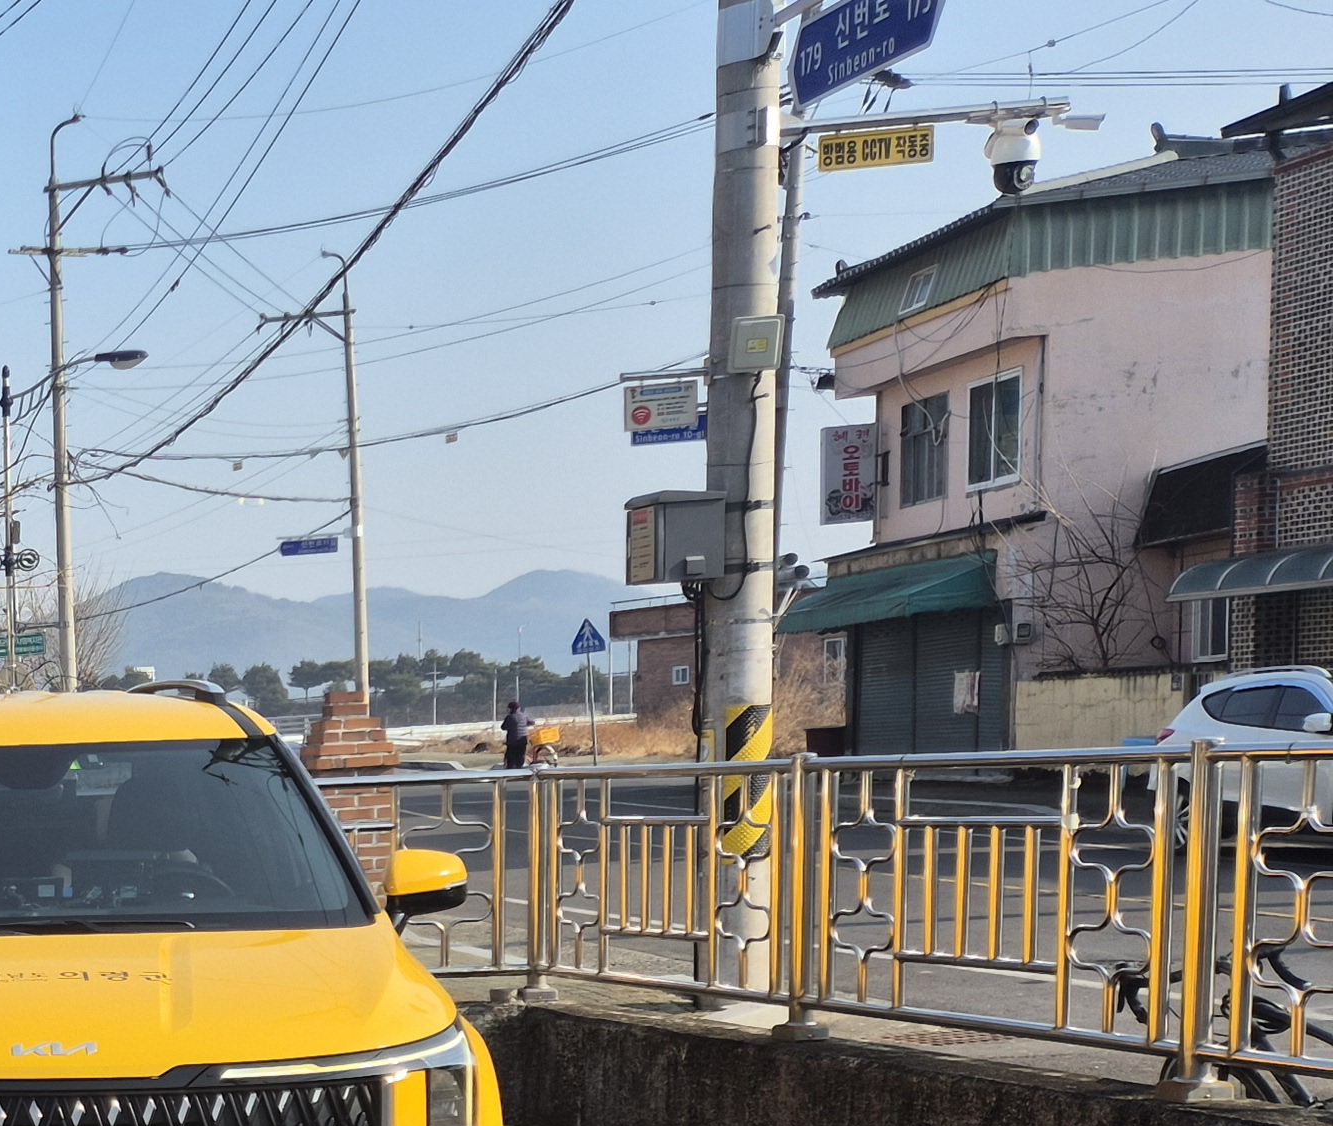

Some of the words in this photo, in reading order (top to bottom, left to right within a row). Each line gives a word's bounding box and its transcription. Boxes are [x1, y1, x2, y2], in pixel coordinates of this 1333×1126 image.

[800, 41, 822, 77] 179
[827, 37, 895, 85] Sinbeon-ro
[823, 140, 857, 167] 방범용
[862, 137, 892, 161] CCTV
[895, 133, 930, 159] 작동중
[842, 445, 862, 509] 오토바이
[58, 971, 172, 985] 의령군
